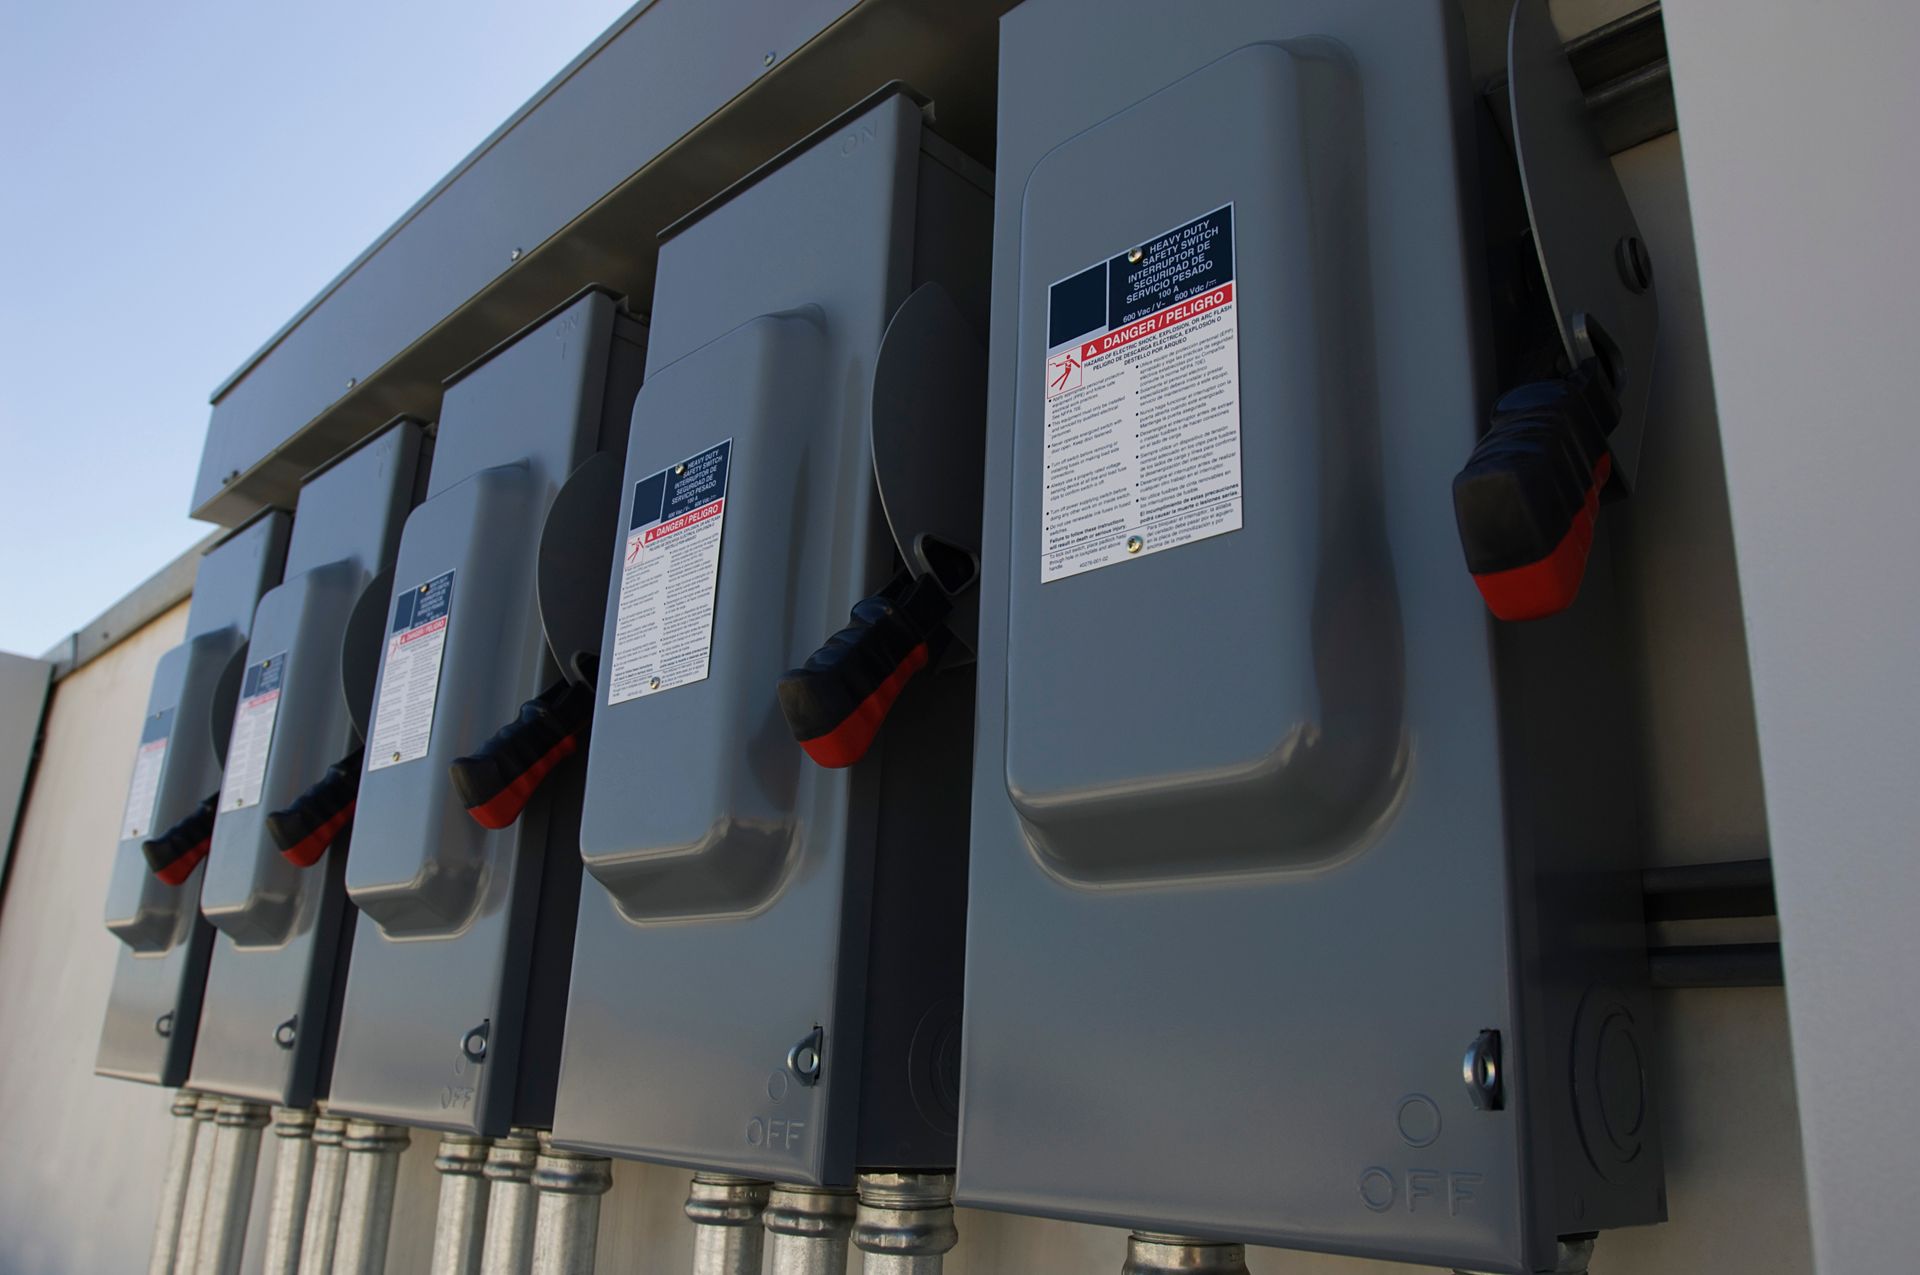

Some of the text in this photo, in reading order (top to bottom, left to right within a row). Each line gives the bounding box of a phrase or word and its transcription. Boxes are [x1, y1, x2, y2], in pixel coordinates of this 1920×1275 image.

[841, 119, 879, 158] ON
[1142, 225, 1218, 267] SAFETY SWITCH
[1149, 219, 1209, 254] HEAVY DUTY
[1127, 239, 1210, 284] INTERRUPTOR DE
[1133, 252, 1205, 291] SEGURIDAD DE
[1125, 258, 1213, 305] SERVICIO PESADO
[1158, 283, 1179, 300] 100 A
[1103, 289, 1224, 349] DANGER / PELIGRO
[1122, 311, 1135, 324] 600
[1136, 305, 1150, 318] Vac
[1174, 289, 1188, 302] 600
[1189, 283, 1204, 296] Vdc
[1083, 355, 1104, 368] HAZARD
[1104, 351, 1112, 360] OF
[1112, 341, 1137, 357] ELECTRIC
[1191, 316, 1199, 325] OR
[1200, 311, 1212, 322] ARC
[1213, 303, 1232, 316] FLASH
[1124, 336, 1186, 366] DESTELLO POR ARQUEO
[1092, 356, 1114, 371] PELIGRO
[1115, 353, 1122, 362] DE
[1123, 342, 1151, 359] DESCARGA
[682, 454, 723, 479] SAFETY SWITCH
[686, 448, 719, 469] HEAVY DUTY
[671, 478, 717, 505] SERVICIO PESADO
[673, 464, 717, 490] INTERRUPTOR DE
[675, 473, 713, 496] SEGURIDAD DE
[655, 517, 684, 537] DANGER
[687, 502, 719, 524] PELIGRO
[441, 1086, 475, 1110] OFF
[745, 1116, 805, 1149] OFF
[1359, 1165, 1484, 1217] OFF
